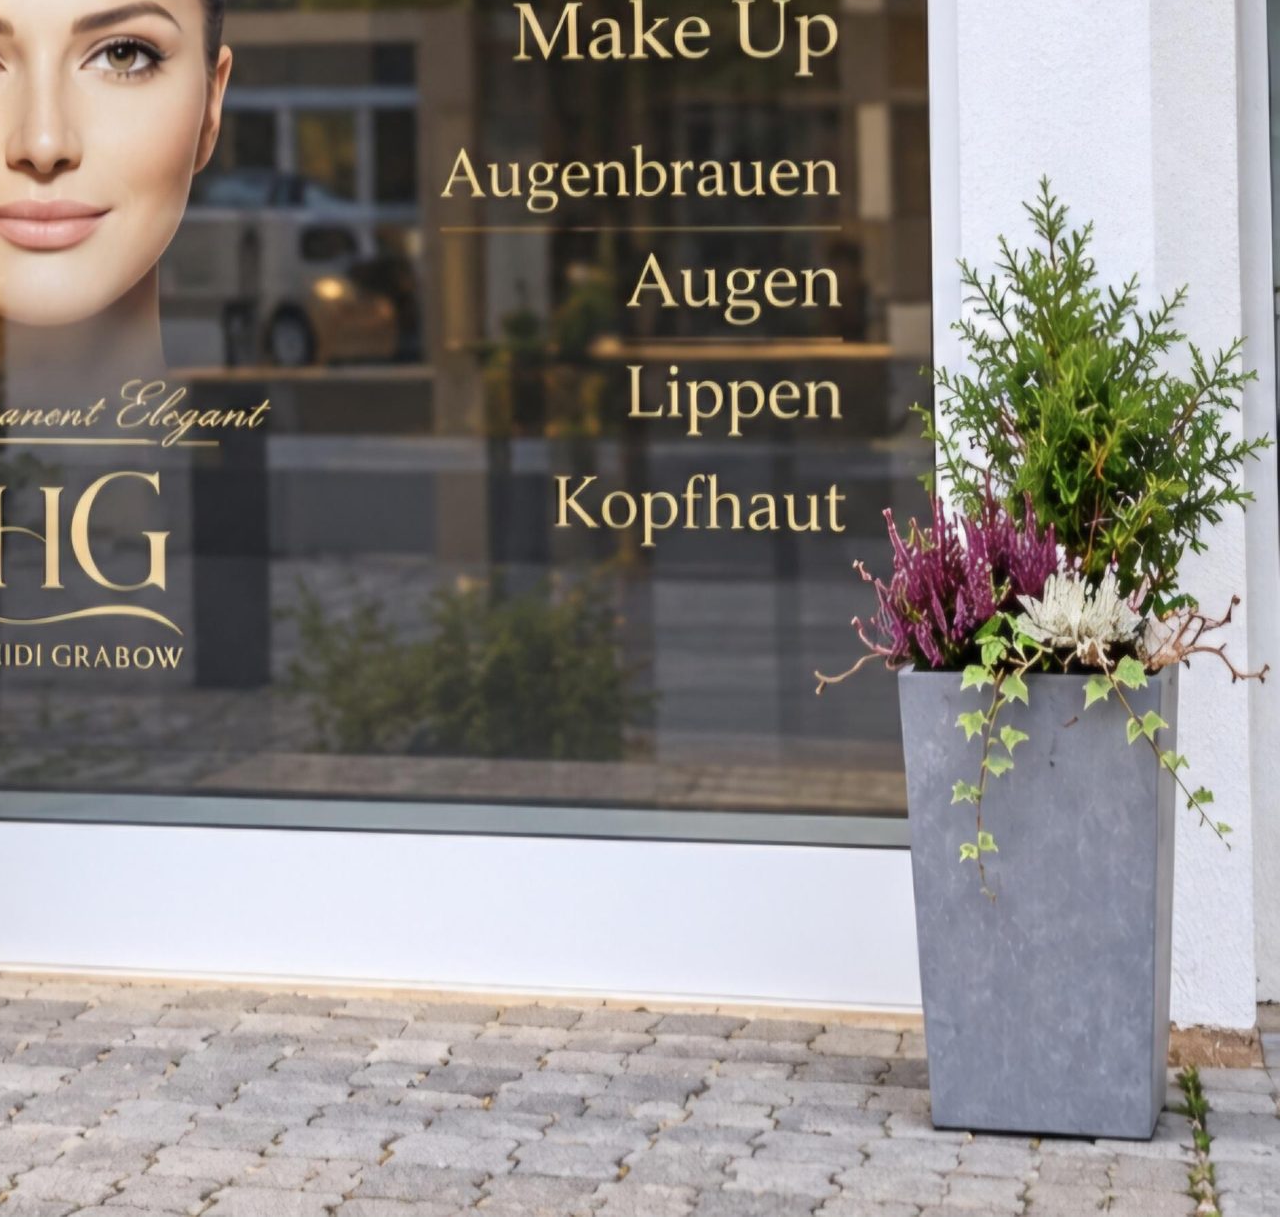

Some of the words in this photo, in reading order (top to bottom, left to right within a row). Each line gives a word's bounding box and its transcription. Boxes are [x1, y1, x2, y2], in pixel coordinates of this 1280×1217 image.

[440, 144, 840, 213] Augenbrauen
[627, 252, 842, 325] Augen
[116, 379, 271, 447] Elegant
[627, 364, 842, 437] Lippen
[554, 474, 846, 547] Kopfhaut
[51, 643, 184, 670] GRABOW
